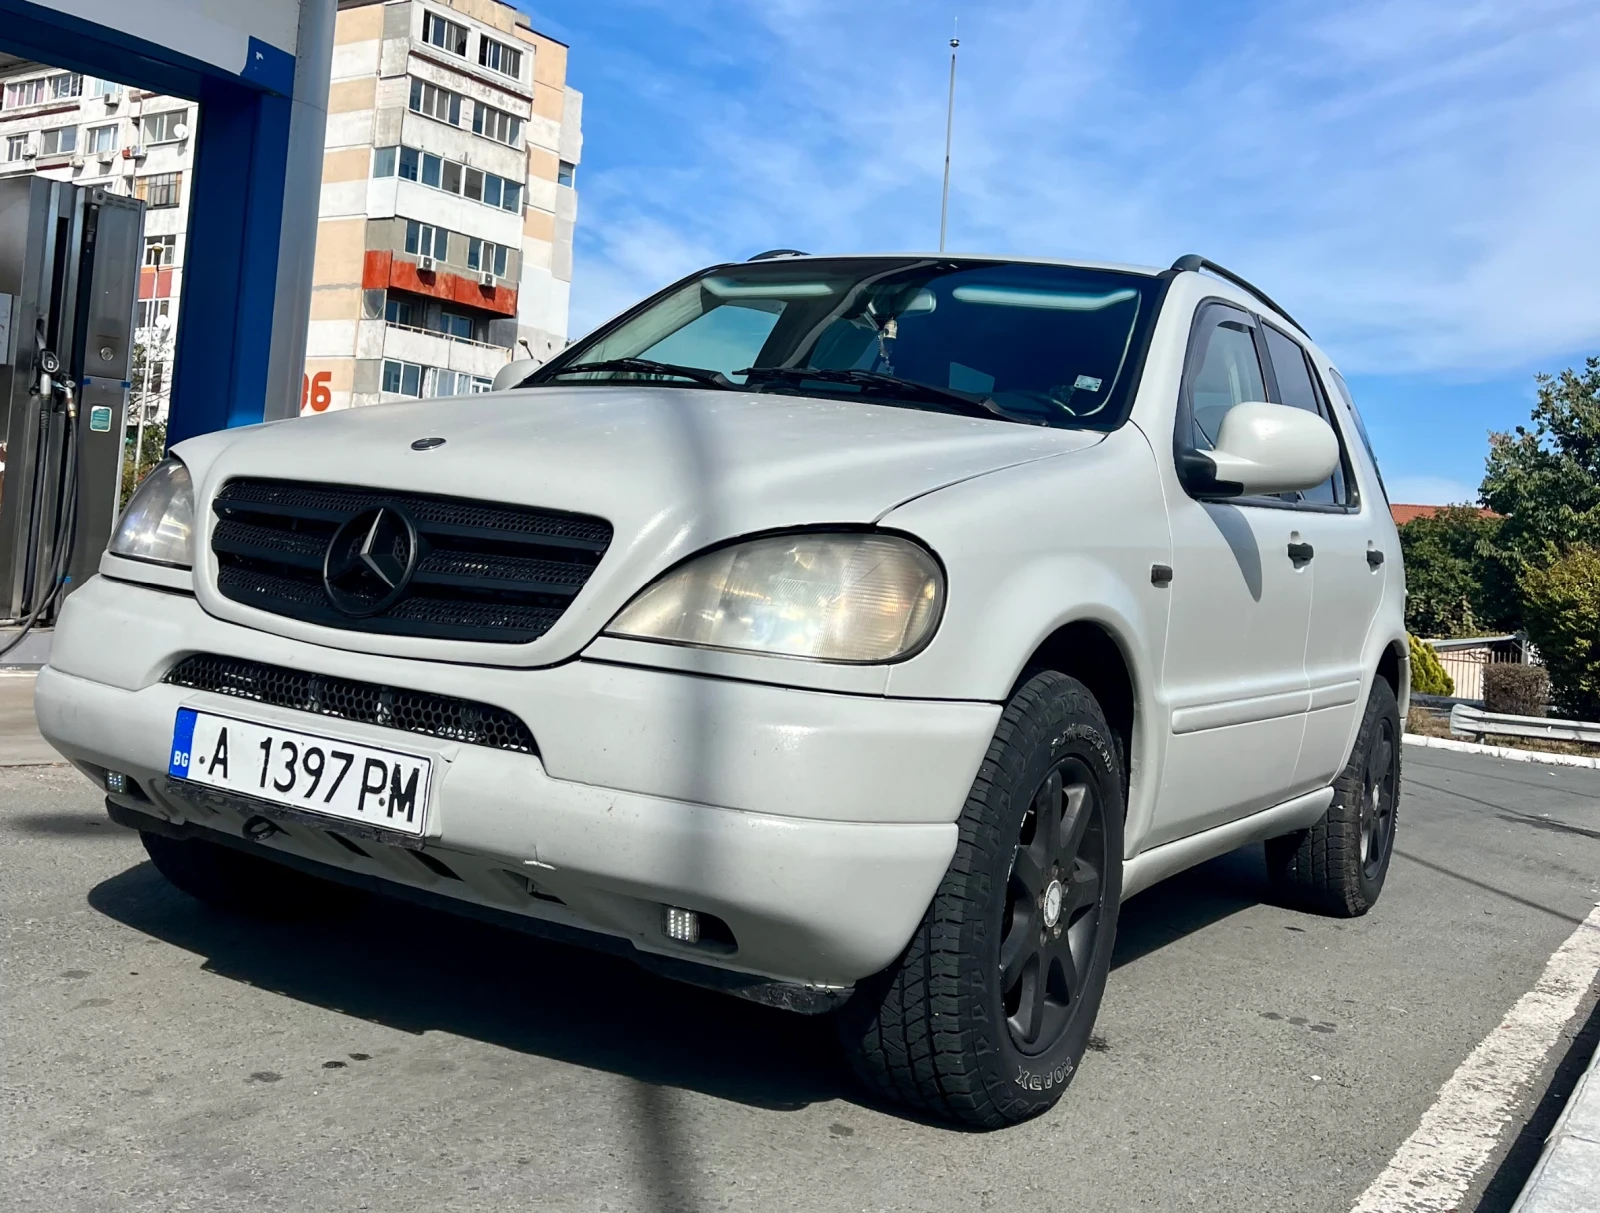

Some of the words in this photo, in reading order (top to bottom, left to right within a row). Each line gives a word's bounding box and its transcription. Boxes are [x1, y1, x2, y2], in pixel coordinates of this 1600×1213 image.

[47, 360, 54, 369] D
[173, 750, 189, 768] BG
[207, 726, 229, 779] A
[259, 736, 355, 803] 1397
[358, 757, 420, 824] PM
[1015, 1056, 1074, 1091] ROADX
